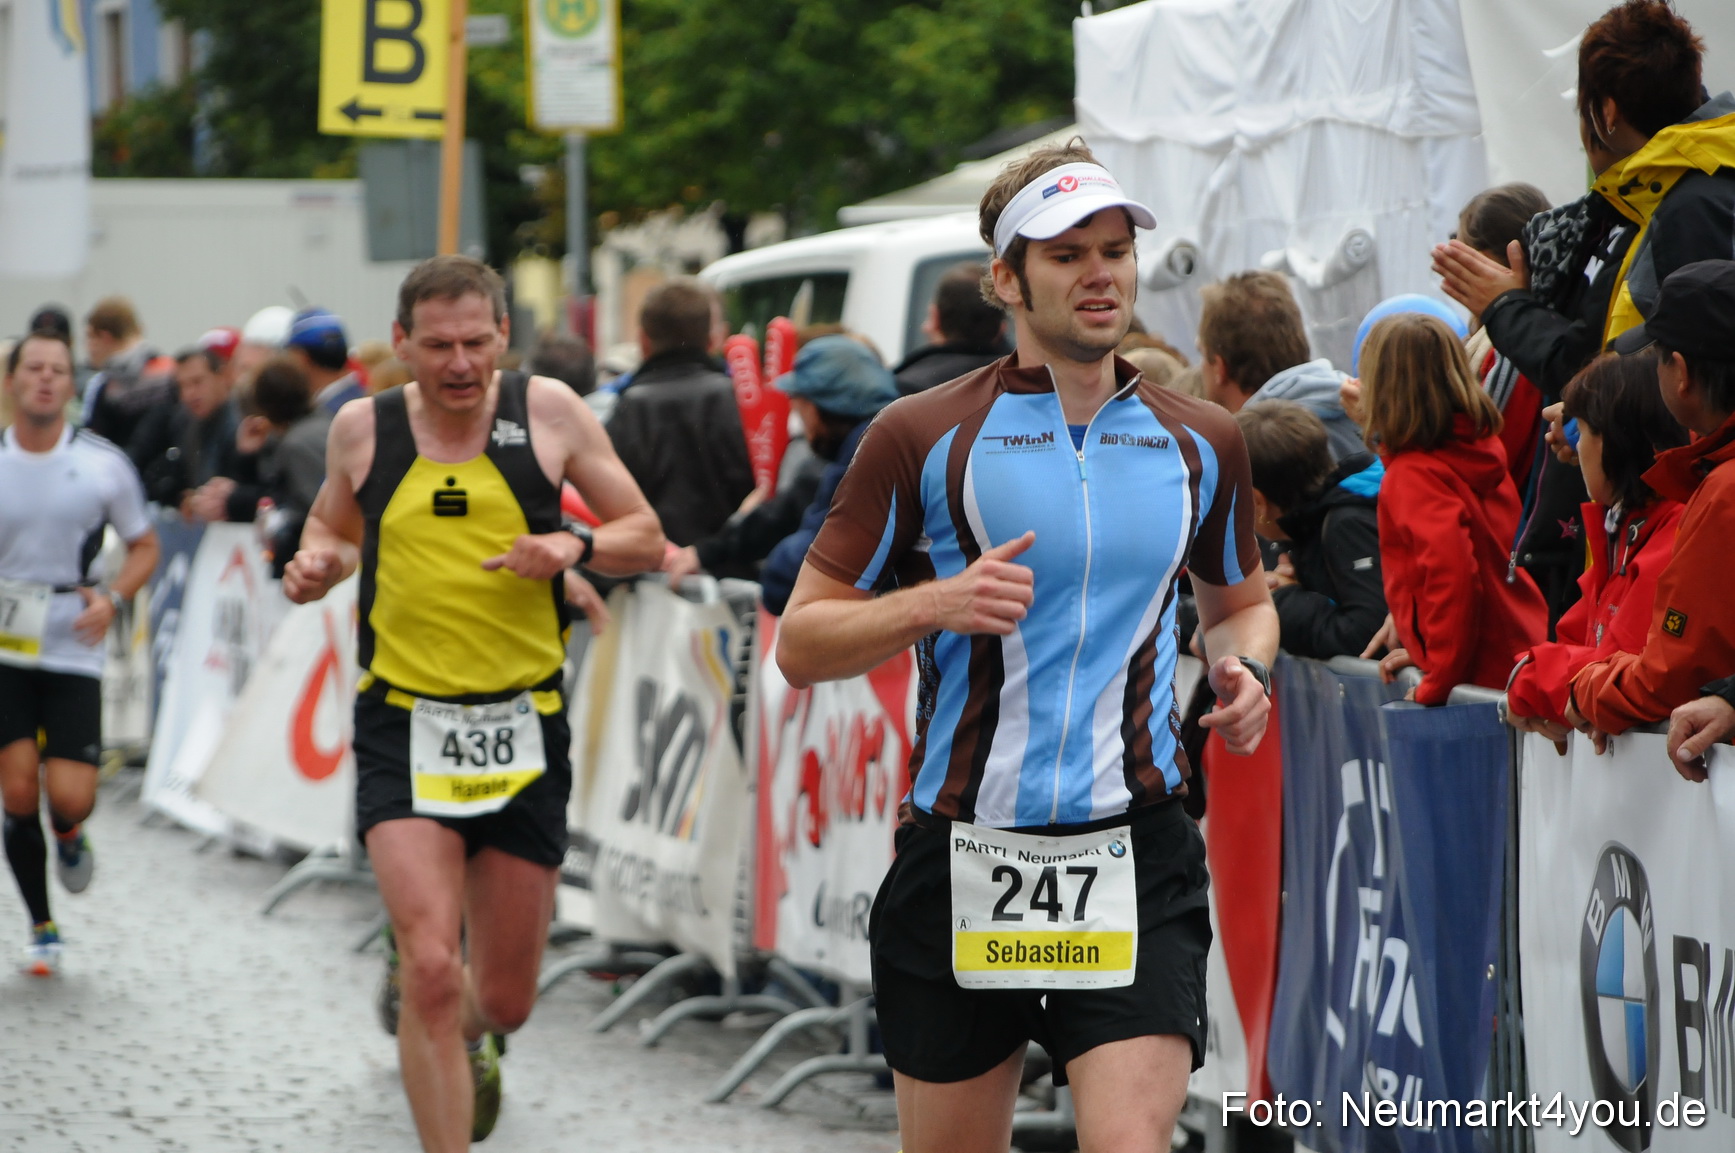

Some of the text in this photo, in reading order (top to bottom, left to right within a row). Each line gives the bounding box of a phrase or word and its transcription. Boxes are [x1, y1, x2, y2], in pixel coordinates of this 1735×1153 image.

[364, 0, 424, 84] B
[1137, 436, 1169, 449] RACER
[441, 727, 514, 767] 438
[992, 865, 1098, 922] 247
[960, 919, 967, 929] A
[986, 940, 1100, 964] Sebastian
